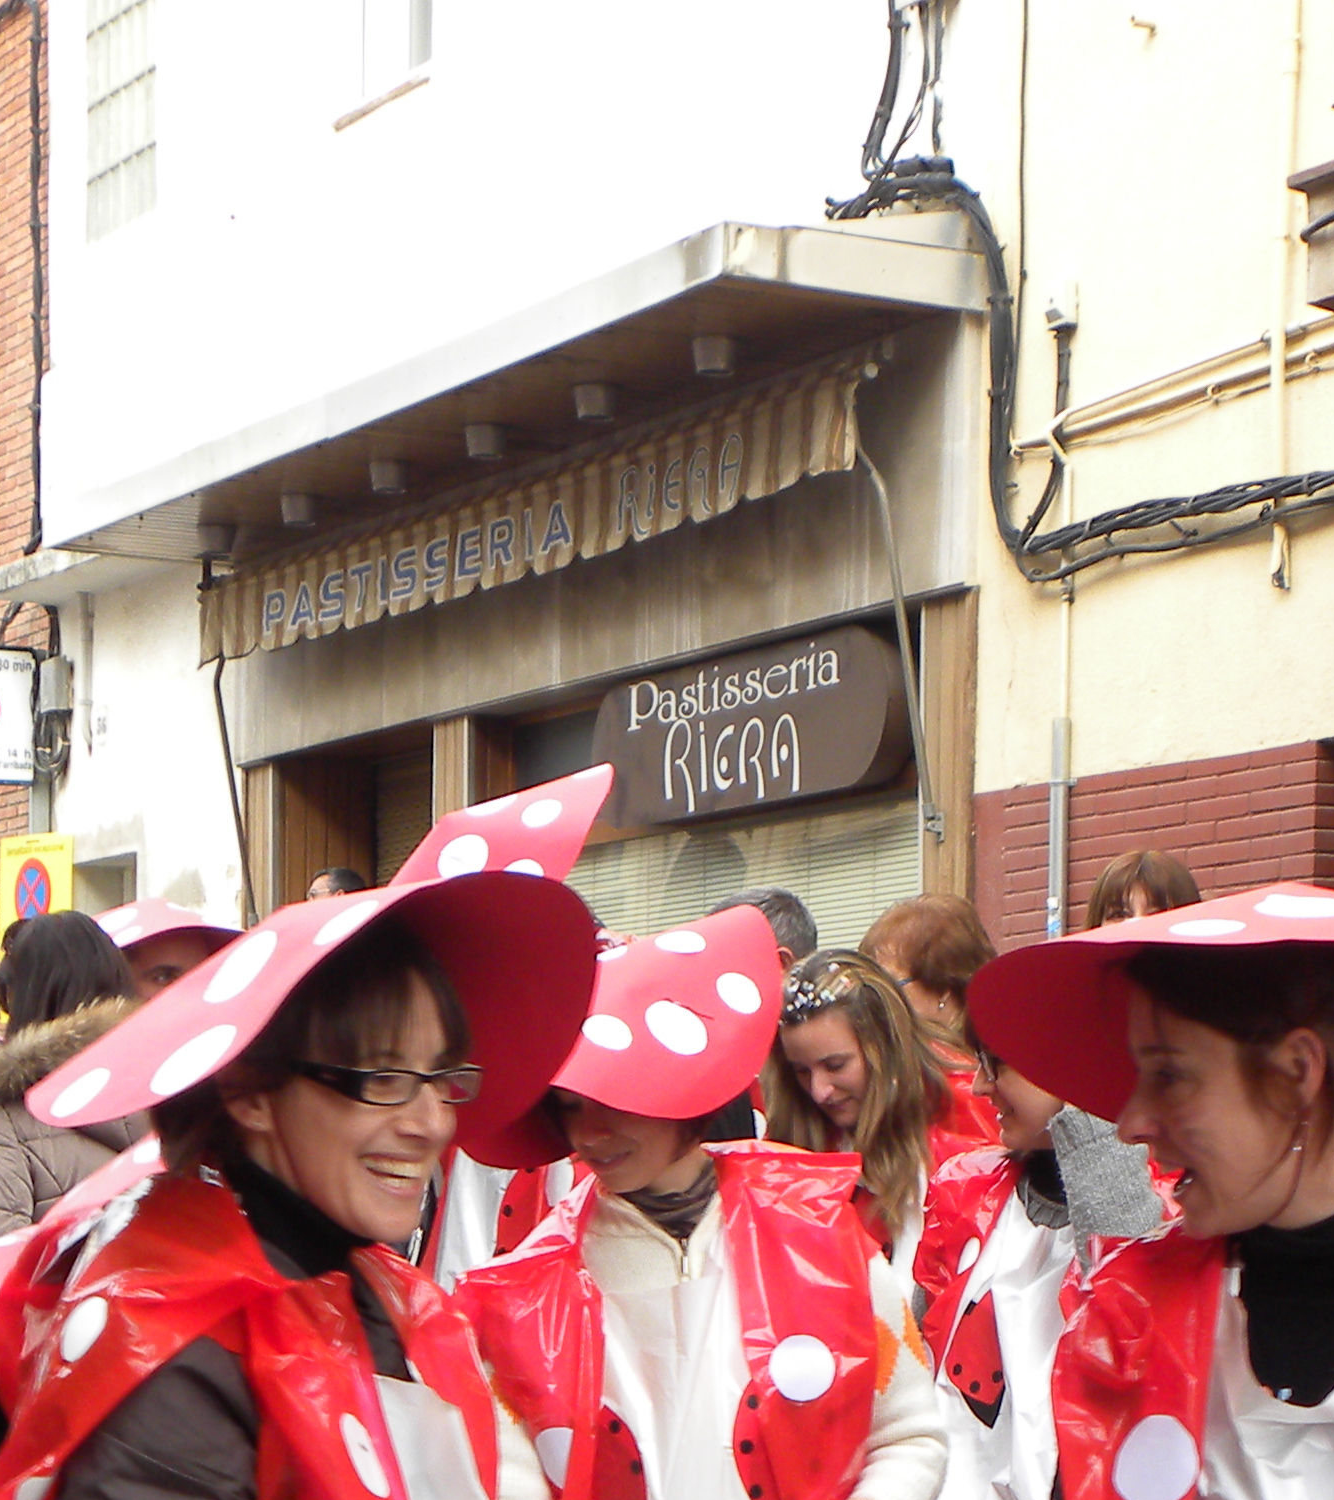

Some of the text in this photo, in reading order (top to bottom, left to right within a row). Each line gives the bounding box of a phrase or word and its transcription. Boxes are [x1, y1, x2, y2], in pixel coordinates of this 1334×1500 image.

[262, 499, 572, 636] PASTISSERIA
[627, 641, 840, 731] Pastisseria
[7, 748, 18, 758] 14
